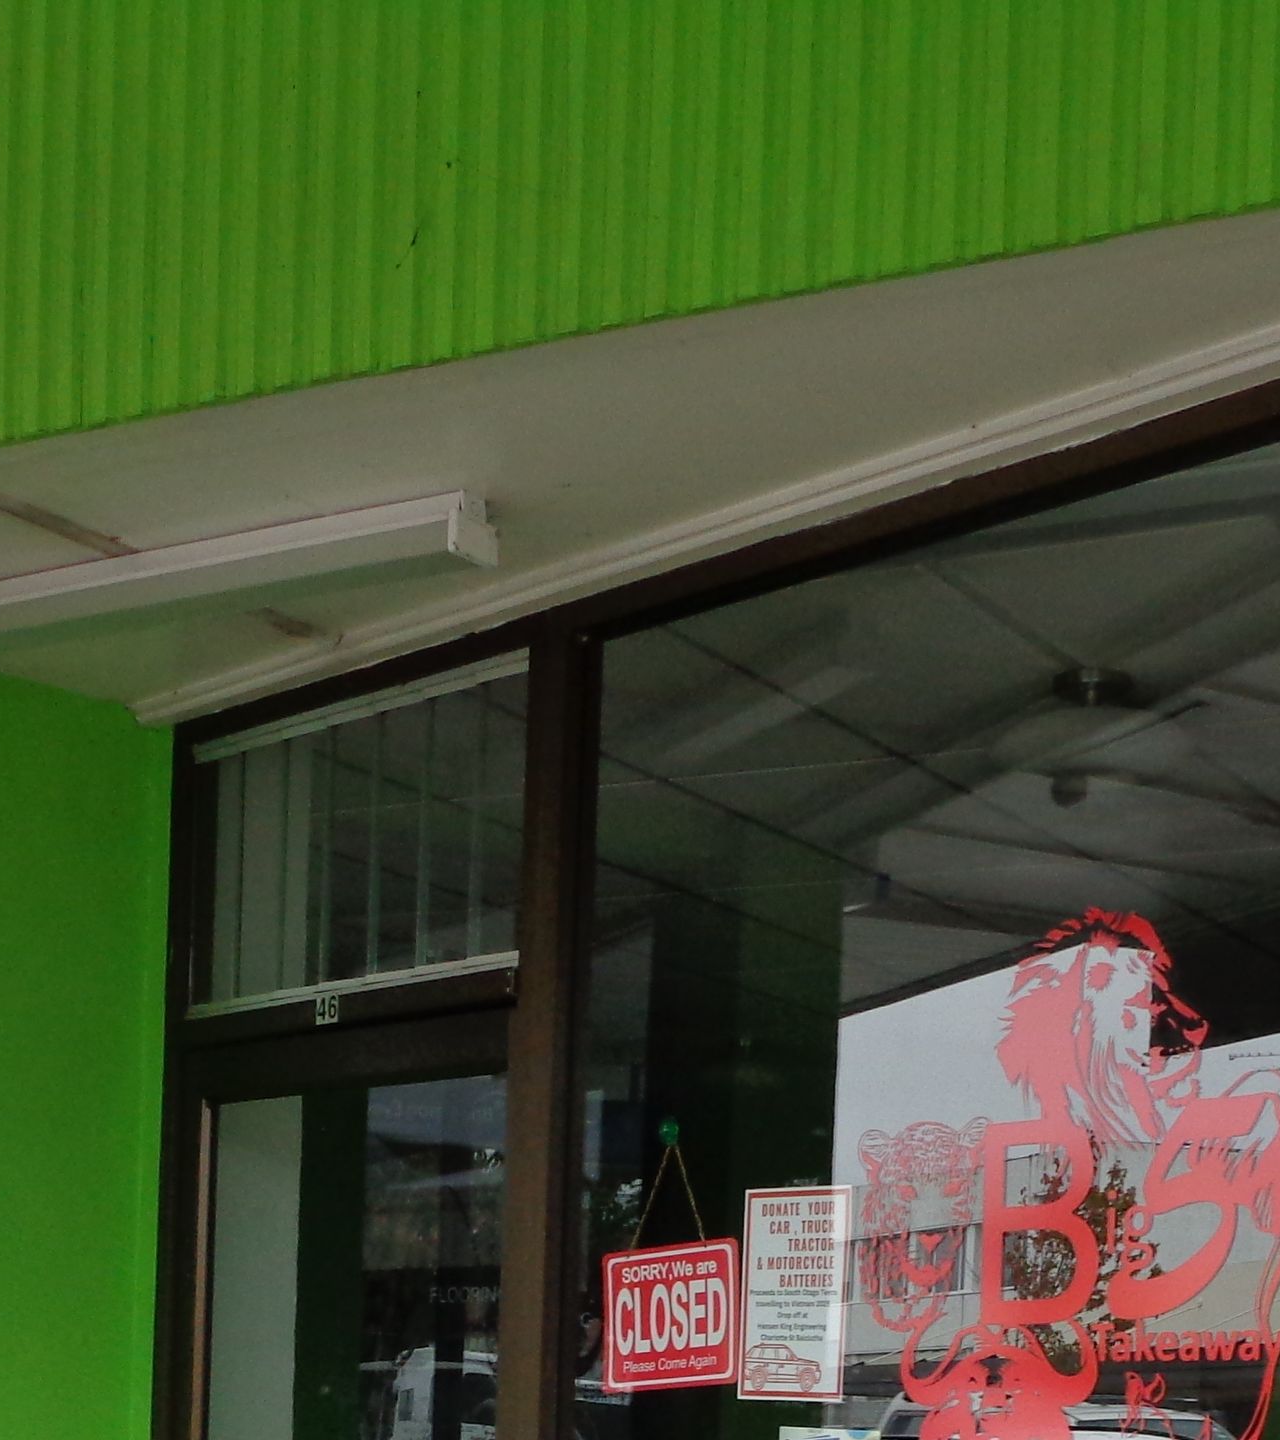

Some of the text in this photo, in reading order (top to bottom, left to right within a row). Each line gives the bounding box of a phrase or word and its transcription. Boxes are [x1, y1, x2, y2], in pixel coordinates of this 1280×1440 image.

[317, 995, 337, 1020] 46
[761, 1201, 835, 1217] DONATE YOUR
[769, 1221, 790, 1234] CAR
[801, 1220, 835, 1233] TRUCK
[788, 1238, 834, 1252] TRACTOR
[696, 1260, 717, 1275] are
[757, 1255, 834, 1270] & MOTORCYCLE
[779, 1274, 833, 1287] BATTERIES
[428, 1285, 503, 1304] FLOORIN
[615, 1277, 727, 1356] CLOSED
[623, 1354, 717, 1373] Please Come Again
